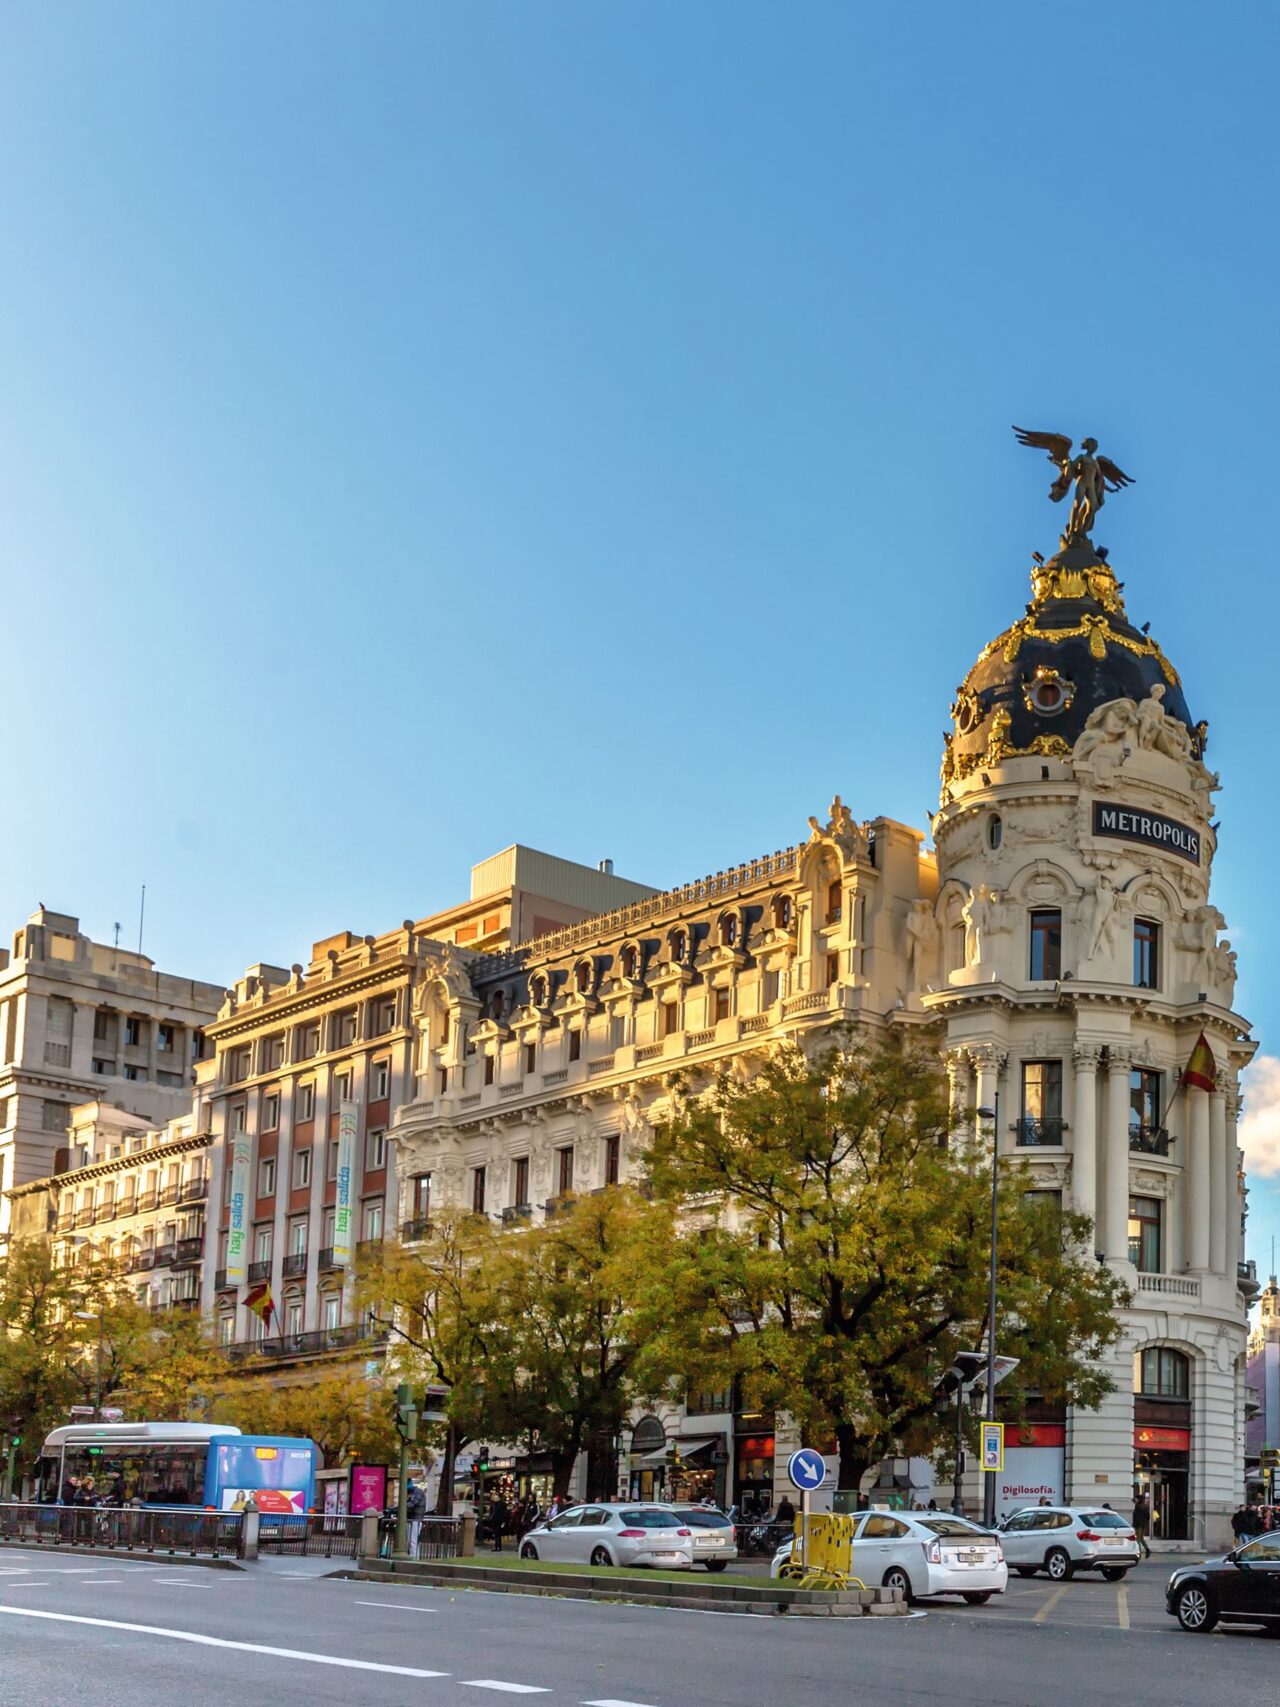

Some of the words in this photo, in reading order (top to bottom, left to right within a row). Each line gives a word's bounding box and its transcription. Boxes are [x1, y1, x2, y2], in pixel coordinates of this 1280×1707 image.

[1101, 810, 1198, 855] METROPOLIS
[336, 1165, 351, 1206] salida
[231, 1192, 244, 1229] salida
[335, 1207, 352, 1233] hay
[229, 1230, 245, 1256] hay
[1002, 1484, 1057, 1496] Digilosofía.
